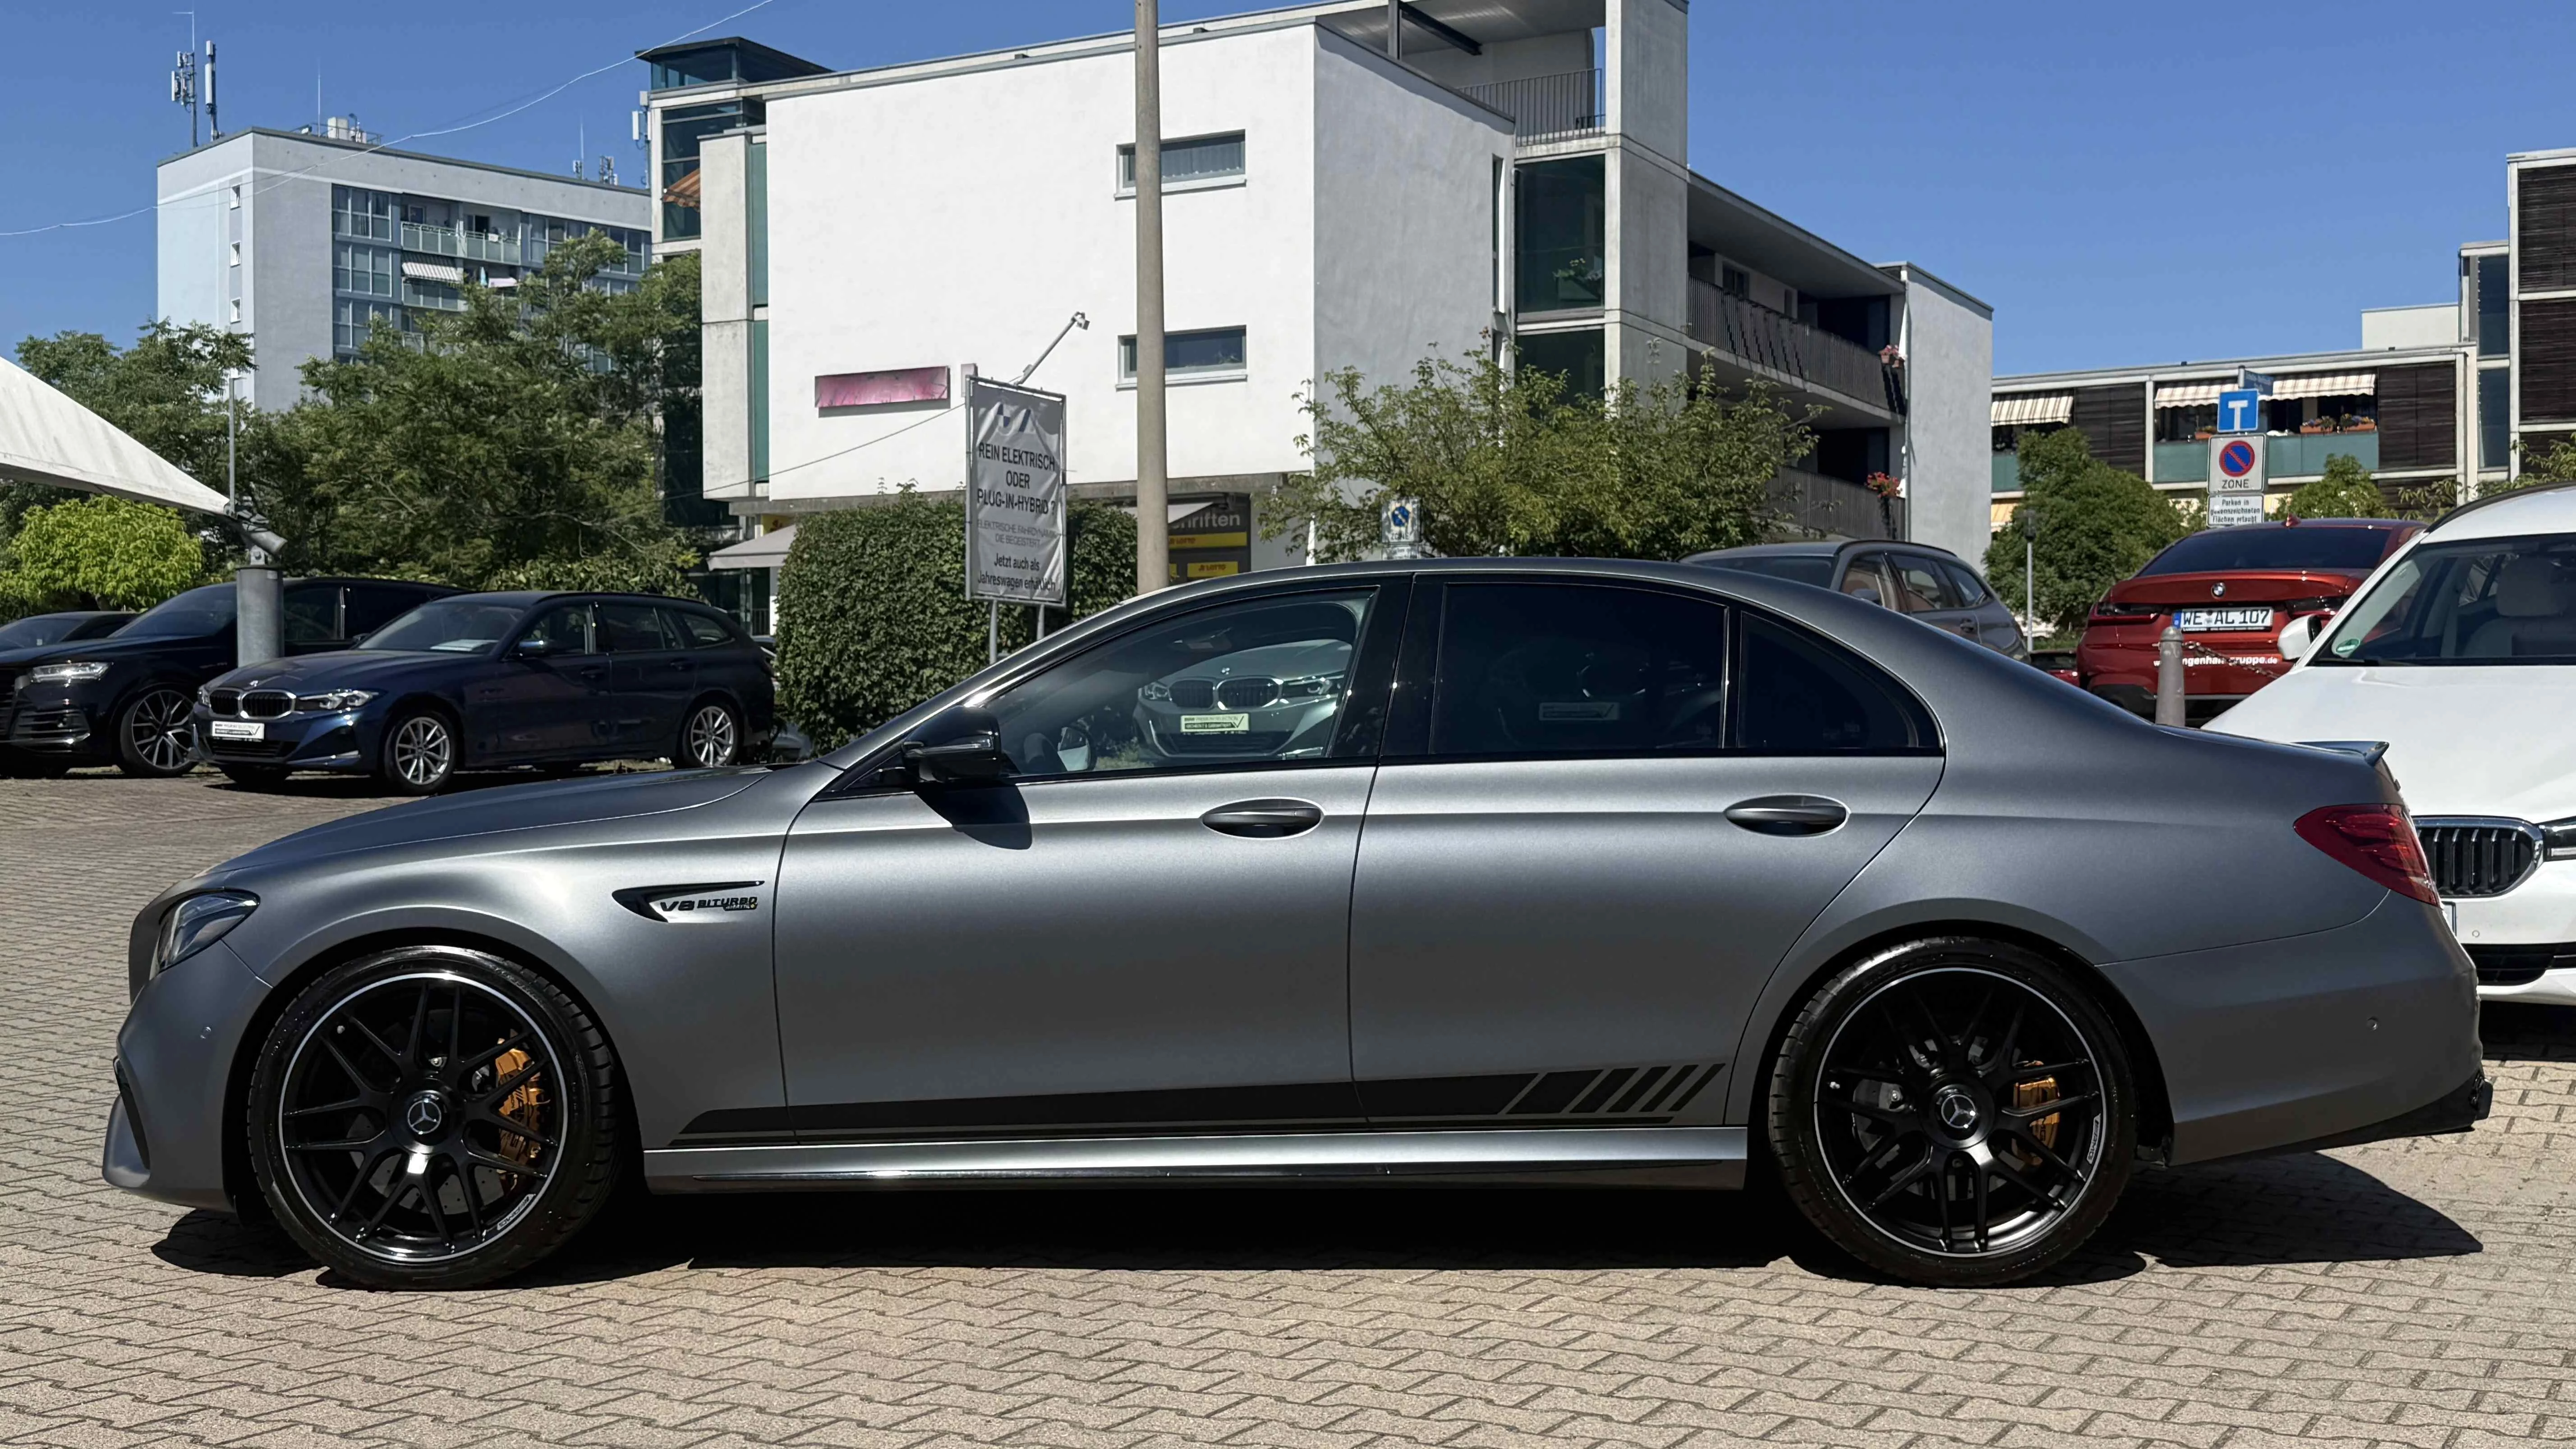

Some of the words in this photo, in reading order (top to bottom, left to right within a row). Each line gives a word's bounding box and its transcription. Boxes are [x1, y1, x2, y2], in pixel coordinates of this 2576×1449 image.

[979, 442, 1000, 461] REIN
[1003, 447, 1055, 471] ELEKTRISCH
[1006, 470, 1030, 489] ODER
[2222, 479, 2249, 489] ZONE
[978, 488, 1049, 514] PLUG-IN-HYBRID
[994, 553, 1011, 568] Jetzt
[1013, 557, 1029, 570] auch
[1030, 558, 1040, 571] als
[978, 570, 1023, 590] Jahreswagen
[2183, 611, 2202, 626] WE
[2214, 610, 2235, 625] AL
[2239, 610, 2270, 625] 107
[660, 901, 695, 911] V8
[697, 897, 757, 908] BITURBO
